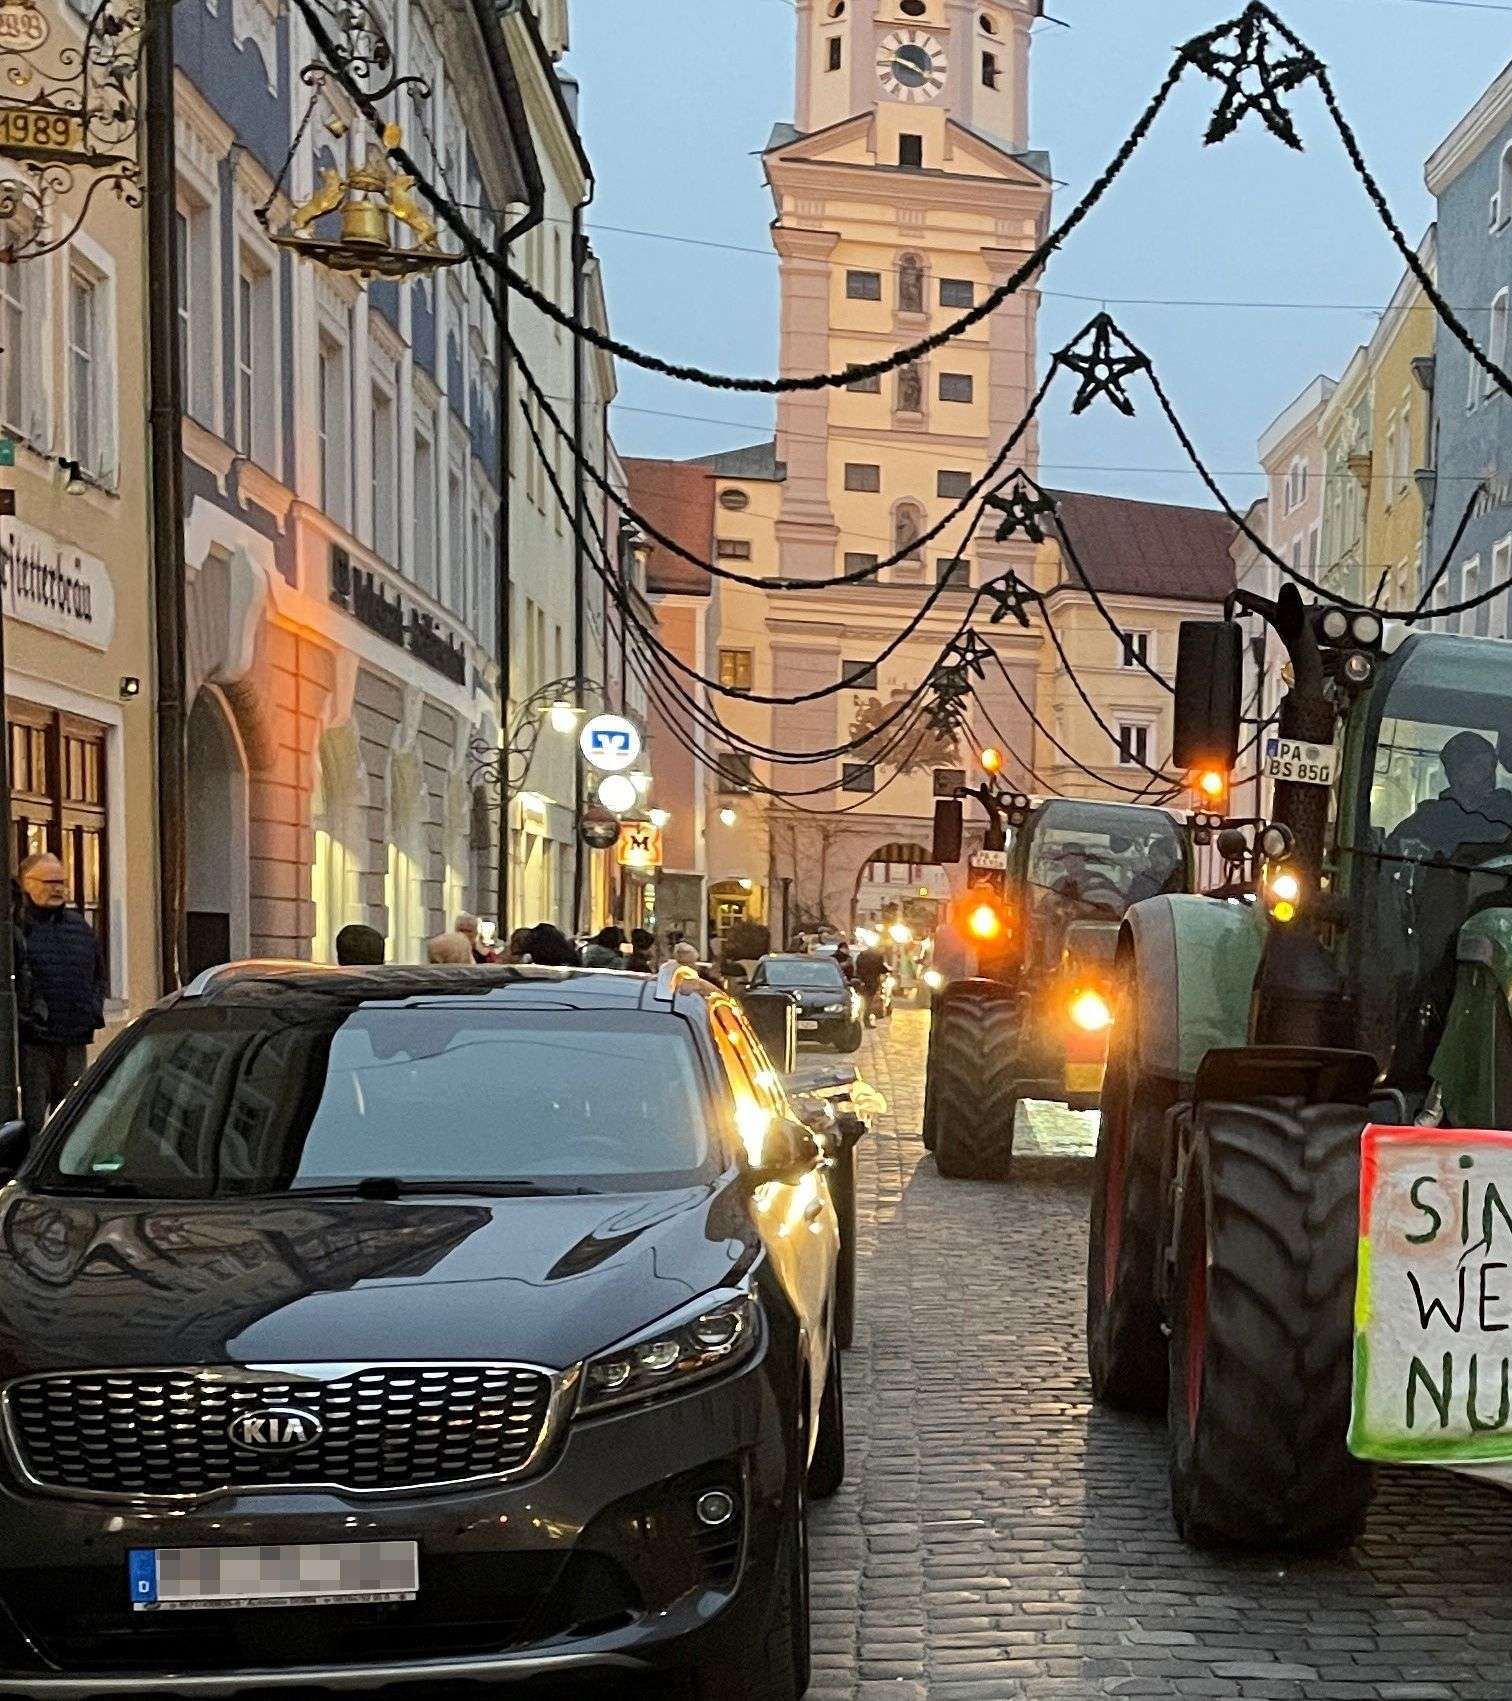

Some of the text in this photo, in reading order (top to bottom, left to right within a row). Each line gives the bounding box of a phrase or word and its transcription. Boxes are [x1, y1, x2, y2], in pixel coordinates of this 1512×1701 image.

[1280, 743, 1301, 761] PA
[1270, 760, 1329, 782] BS 850
[242, 1417, 307, 1443] KIA
[138, 1580, 150, 1593] D
